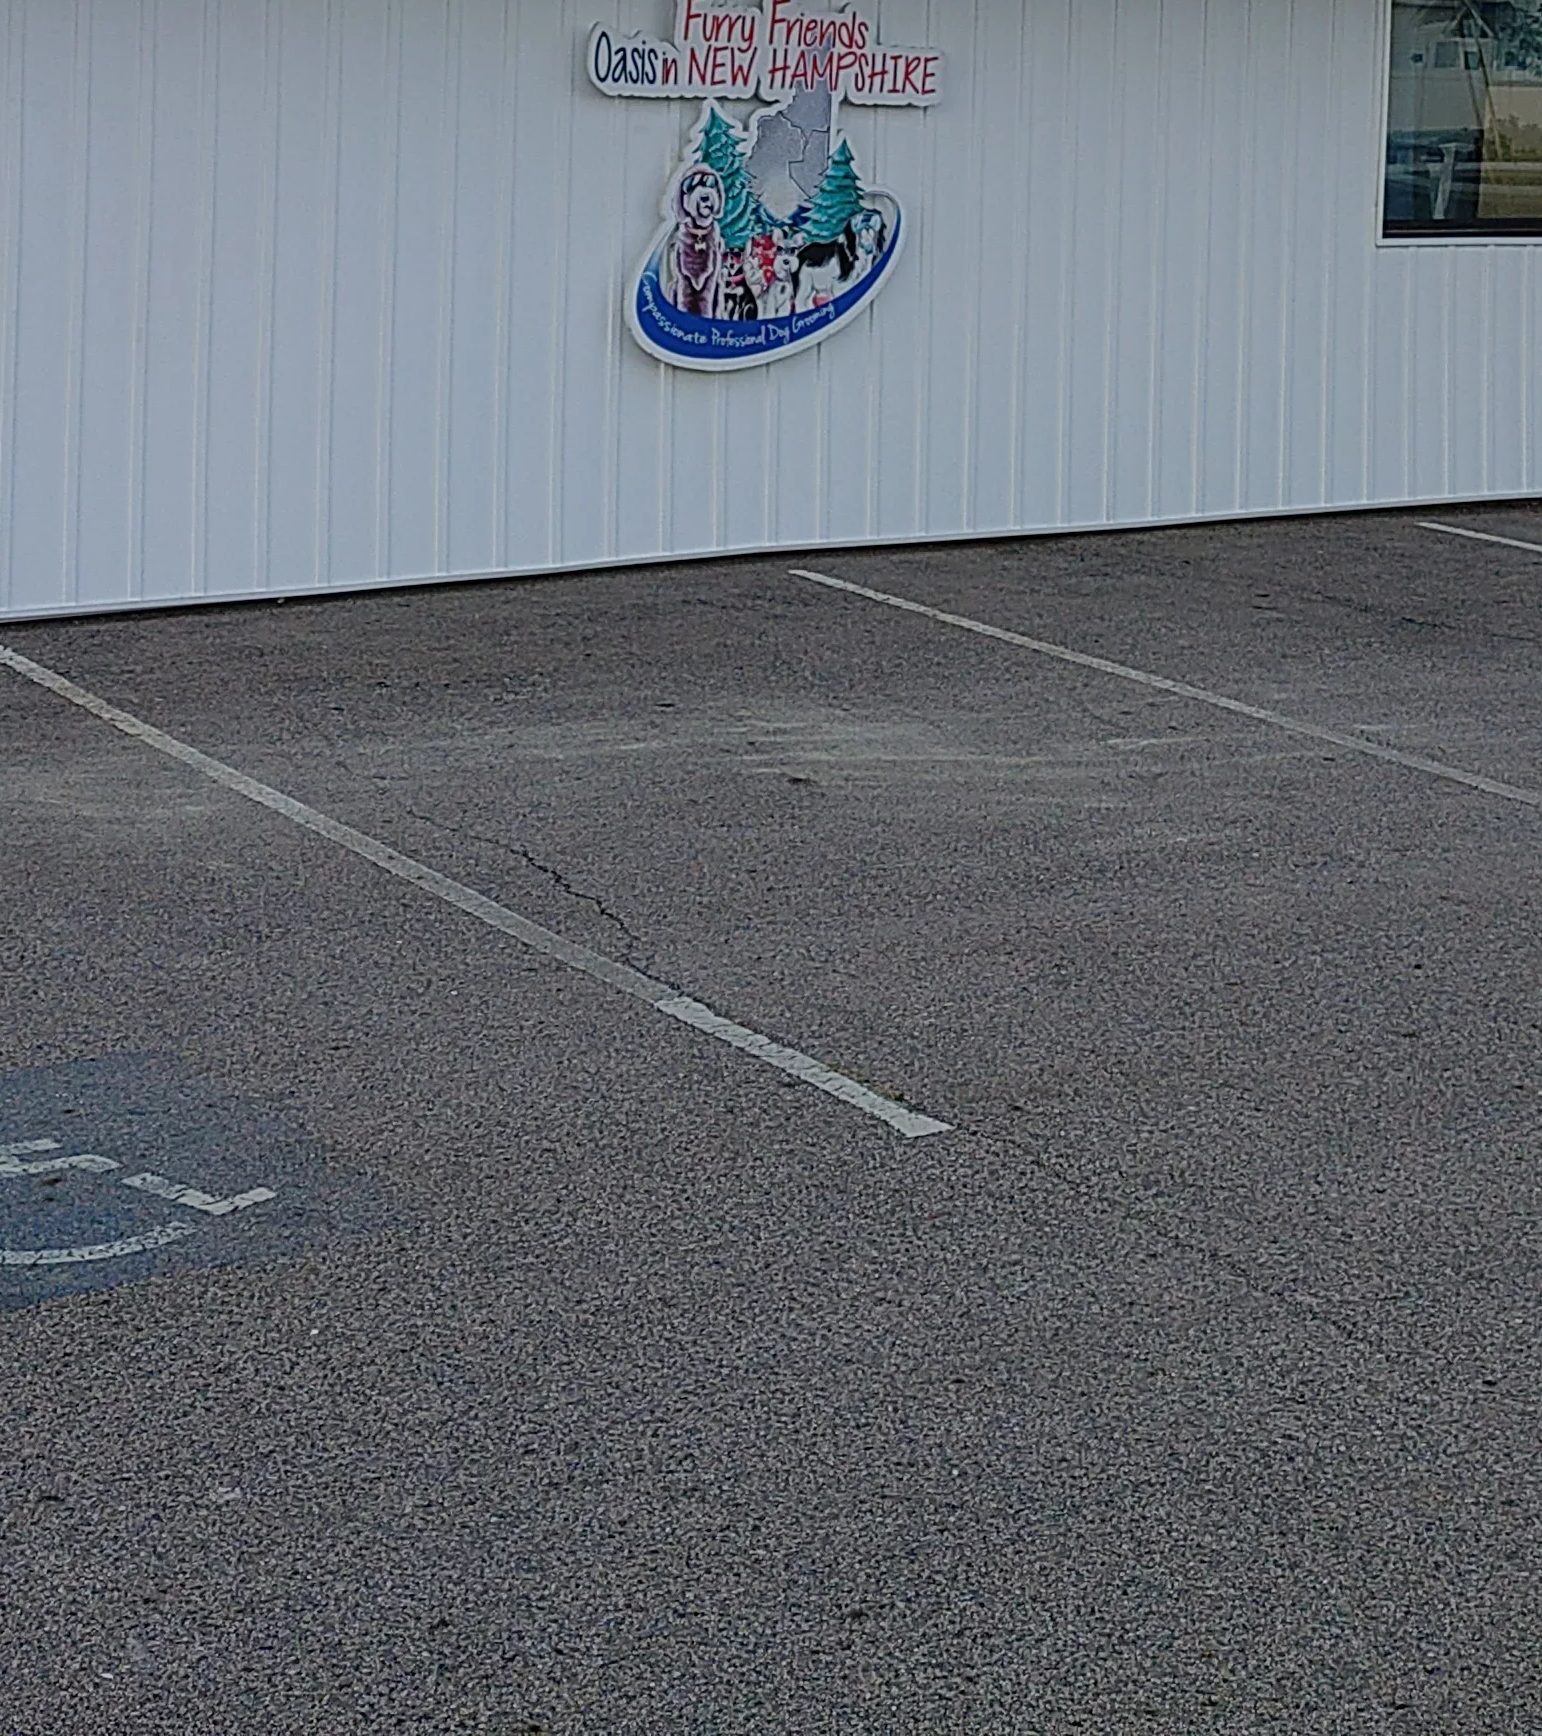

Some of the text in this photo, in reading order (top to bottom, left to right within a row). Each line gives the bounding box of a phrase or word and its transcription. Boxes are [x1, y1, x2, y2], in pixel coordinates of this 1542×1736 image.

[594, 31, 940, 95] Oasis in NEW HAMPSHIRE
[639, 270, 837, 348] Compassionate Professional Dog Grooming
